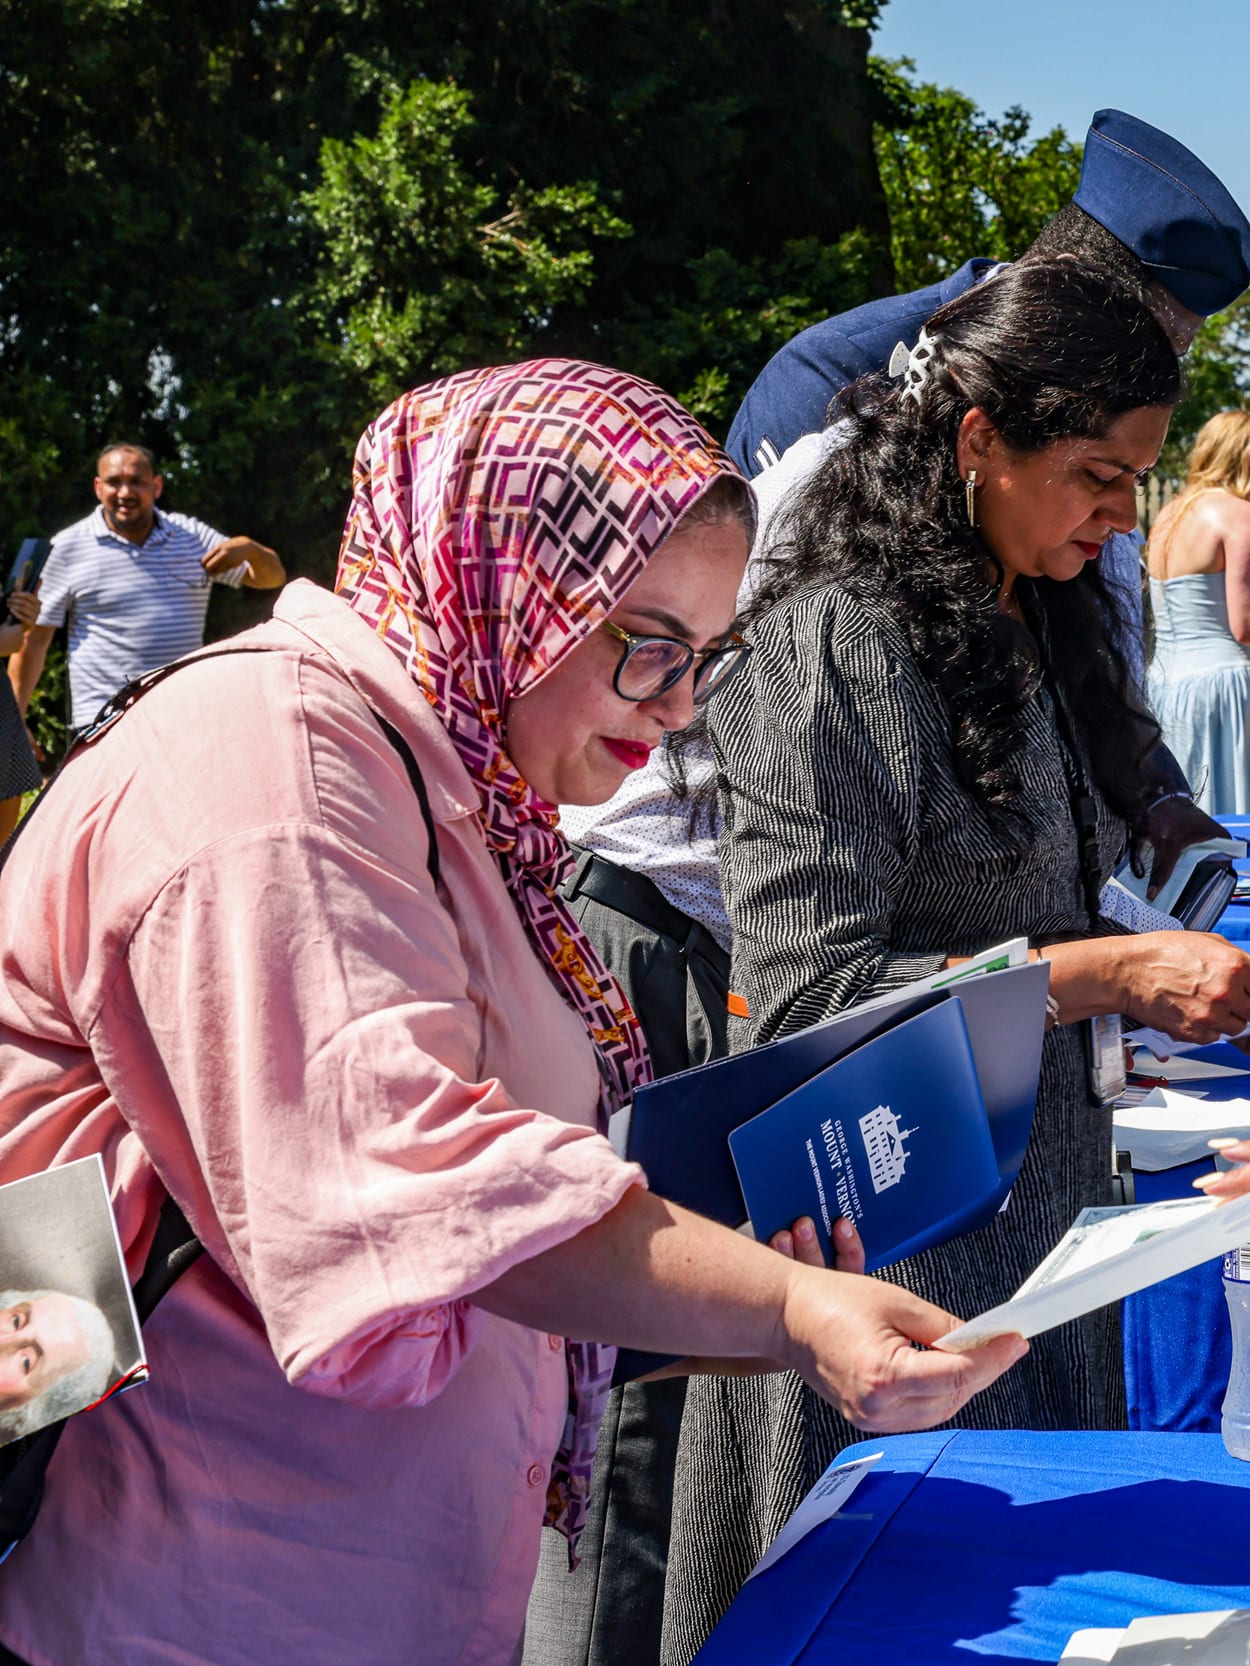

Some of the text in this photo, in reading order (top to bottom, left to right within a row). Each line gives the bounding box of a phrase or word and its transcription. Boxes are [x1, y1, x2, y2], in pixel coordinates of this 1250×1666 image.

[820, 1118, 843, 1170] MOUNT
[834, 1119, 864, 1219] GEORGE WASHINGTON'S
[820, 1204, 833, 1237] ASSOCIATION
